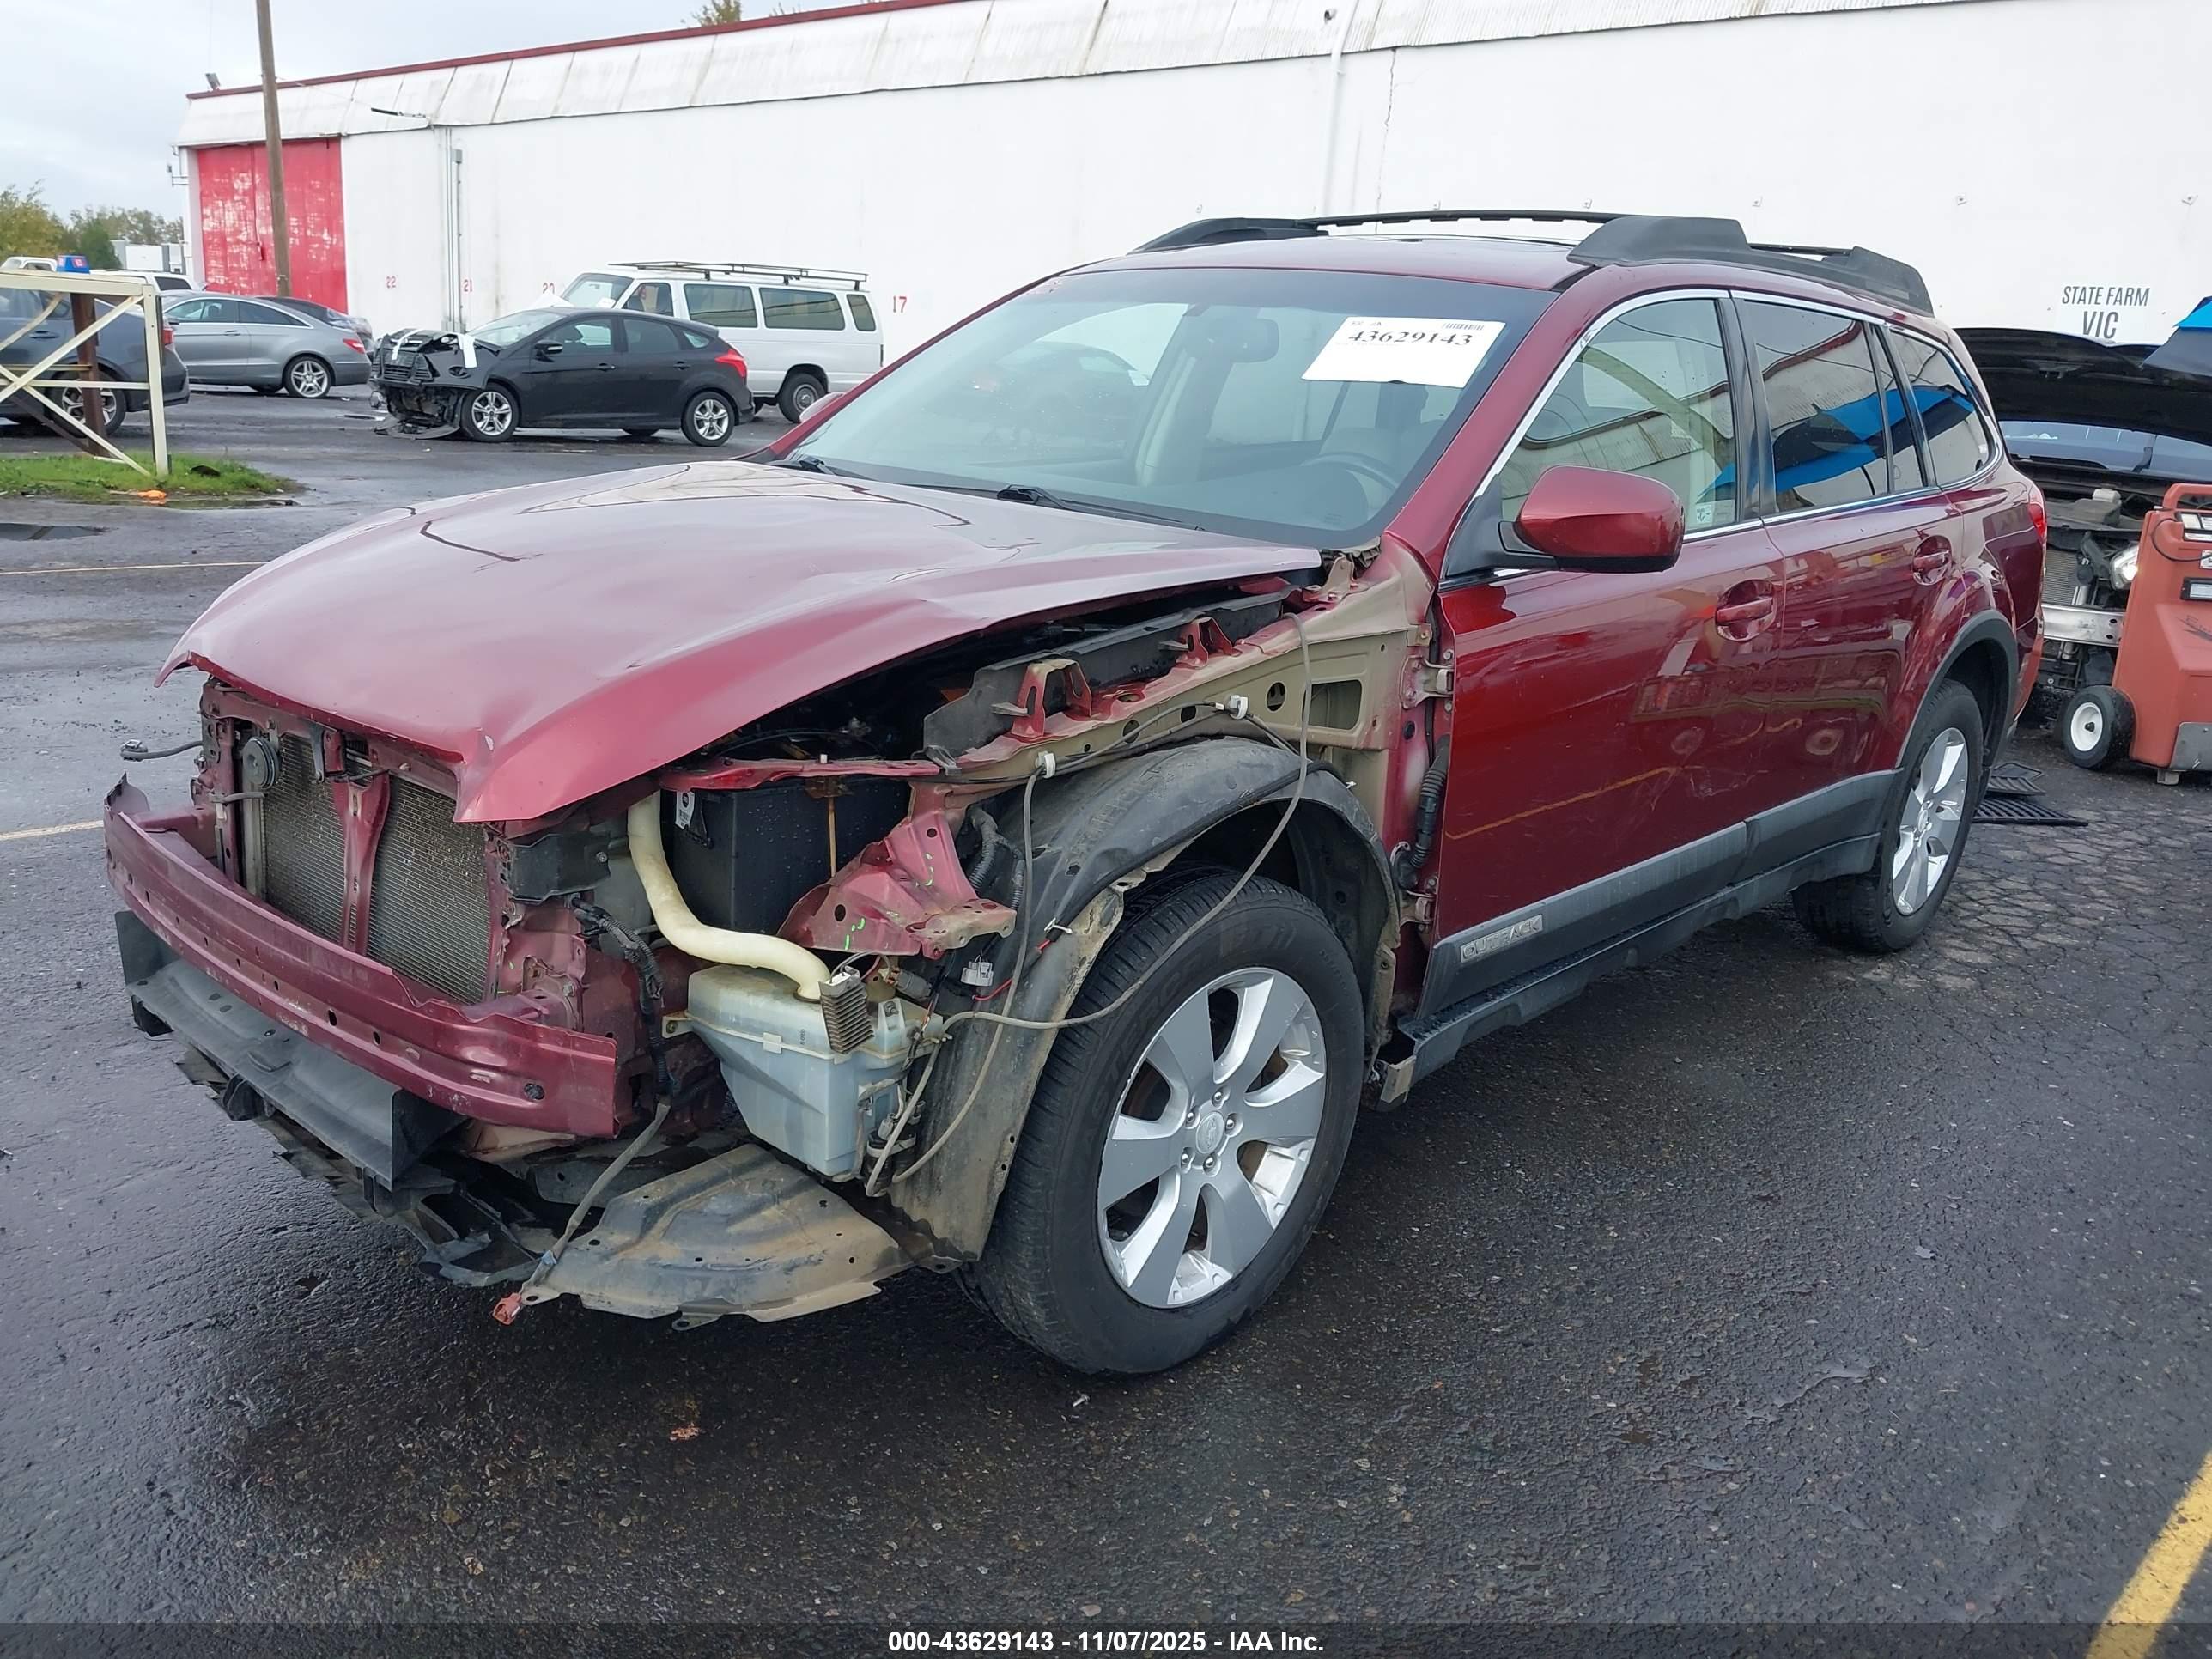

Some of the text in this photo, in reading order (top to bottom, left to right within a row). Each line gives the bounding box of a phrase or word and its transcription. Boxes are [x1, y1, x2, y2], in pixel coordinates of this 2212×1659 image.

[386, 276, 397, 289] 22
[463, 279, 472, 292] 21
[892, 295, 907, 313] 17
[2062, 286, 2150, 307] STATE FARM
[2082, 310, 2119, 339] VIC
[1348, 331, 1473, 345] 43629143
